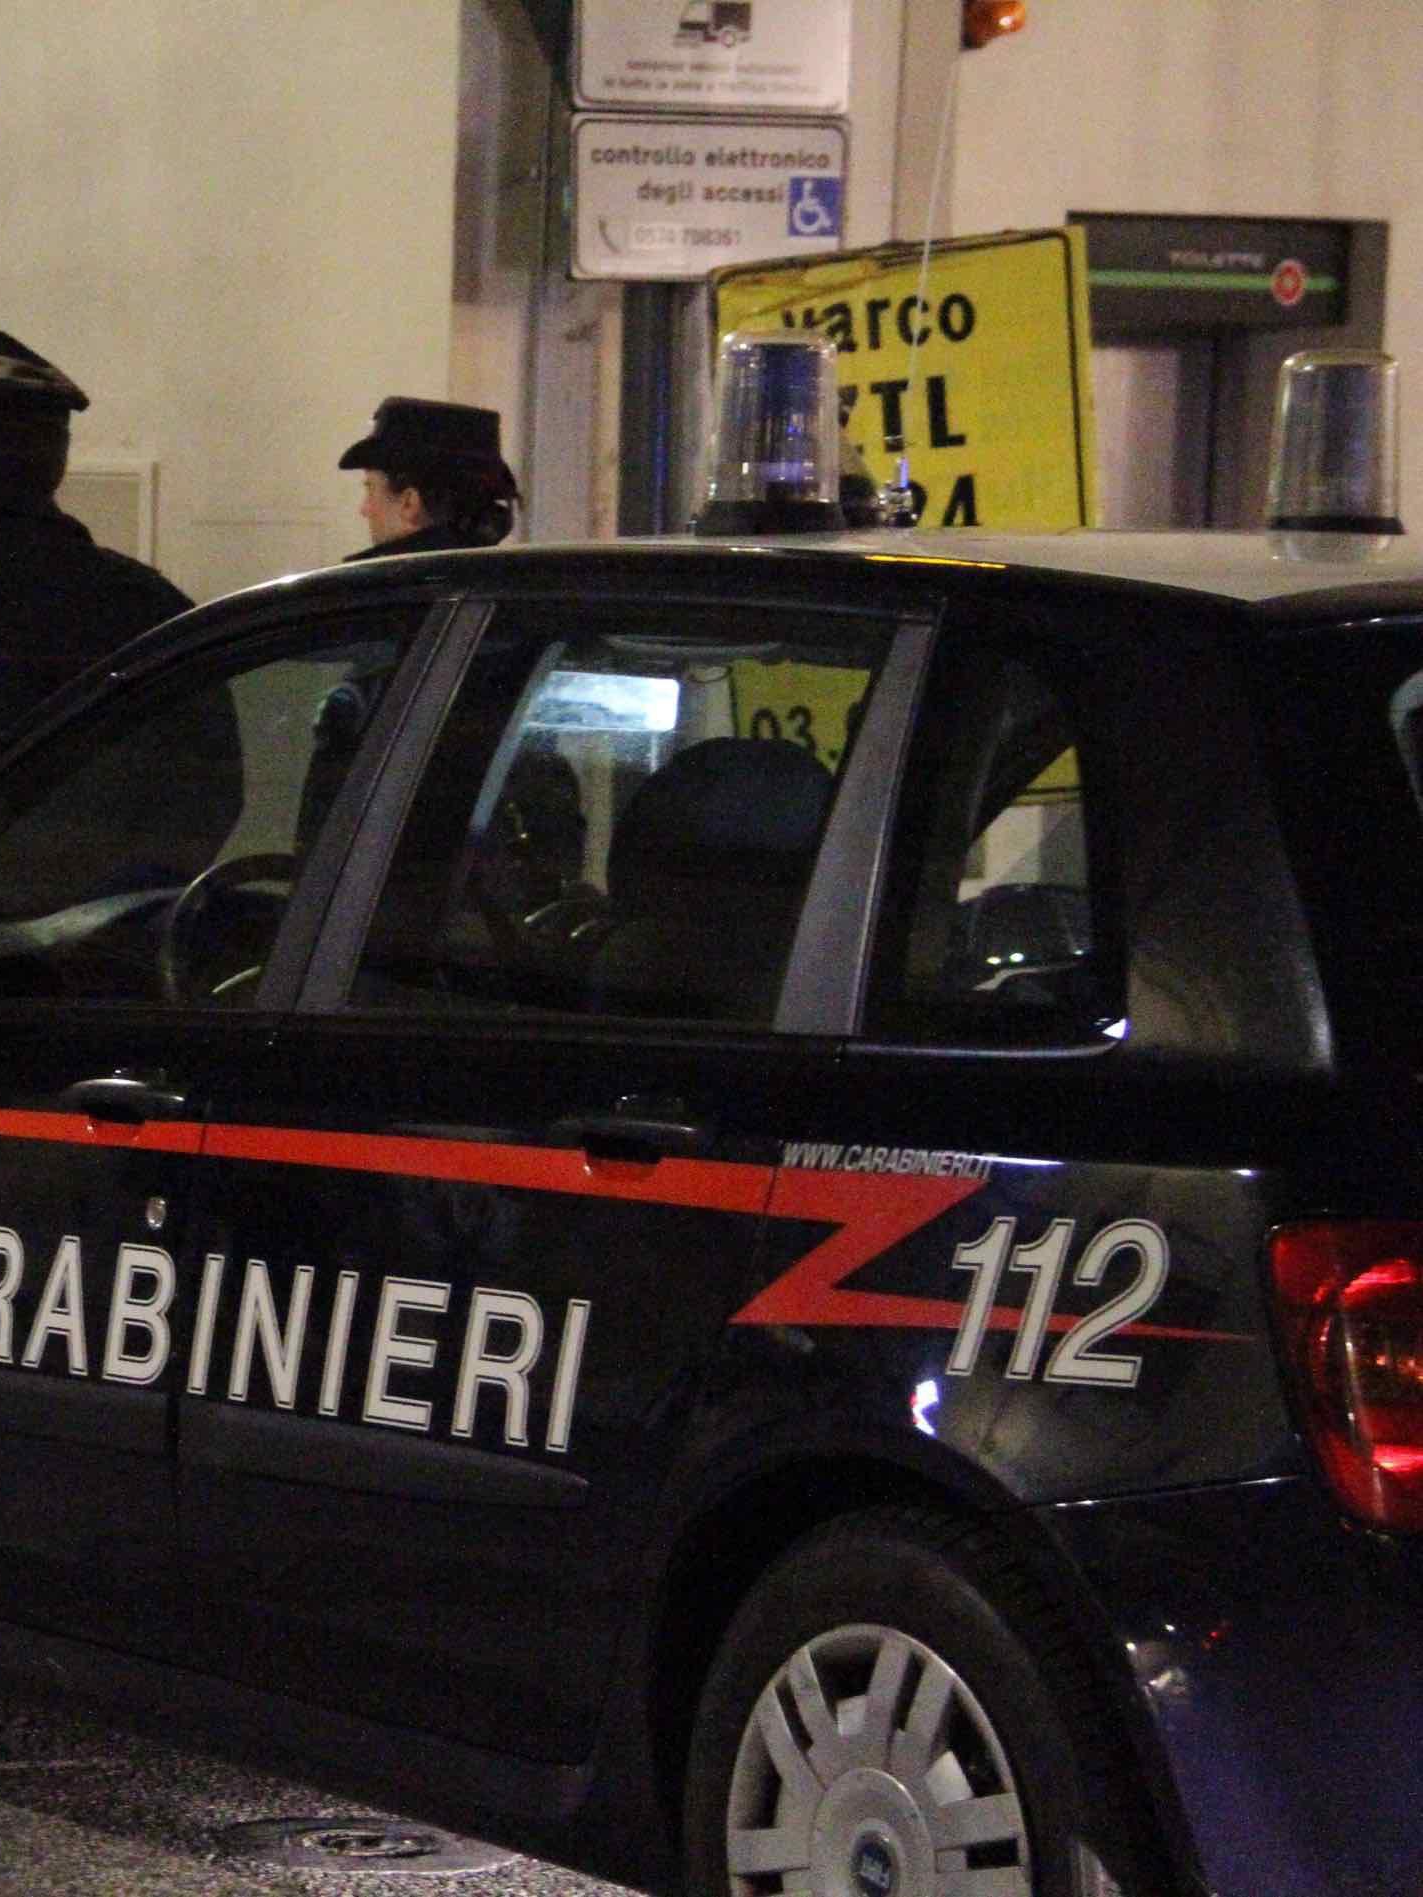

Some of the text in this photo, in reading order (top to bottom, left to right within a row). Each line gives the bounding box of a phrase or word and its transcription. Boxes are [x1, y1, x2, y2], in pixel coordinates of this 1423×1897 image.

[590, 146, 831, 168] controllo elettronico
[637, 181, 784, 205] degli accessi
[945, 1215, 1170, 1388] 112
